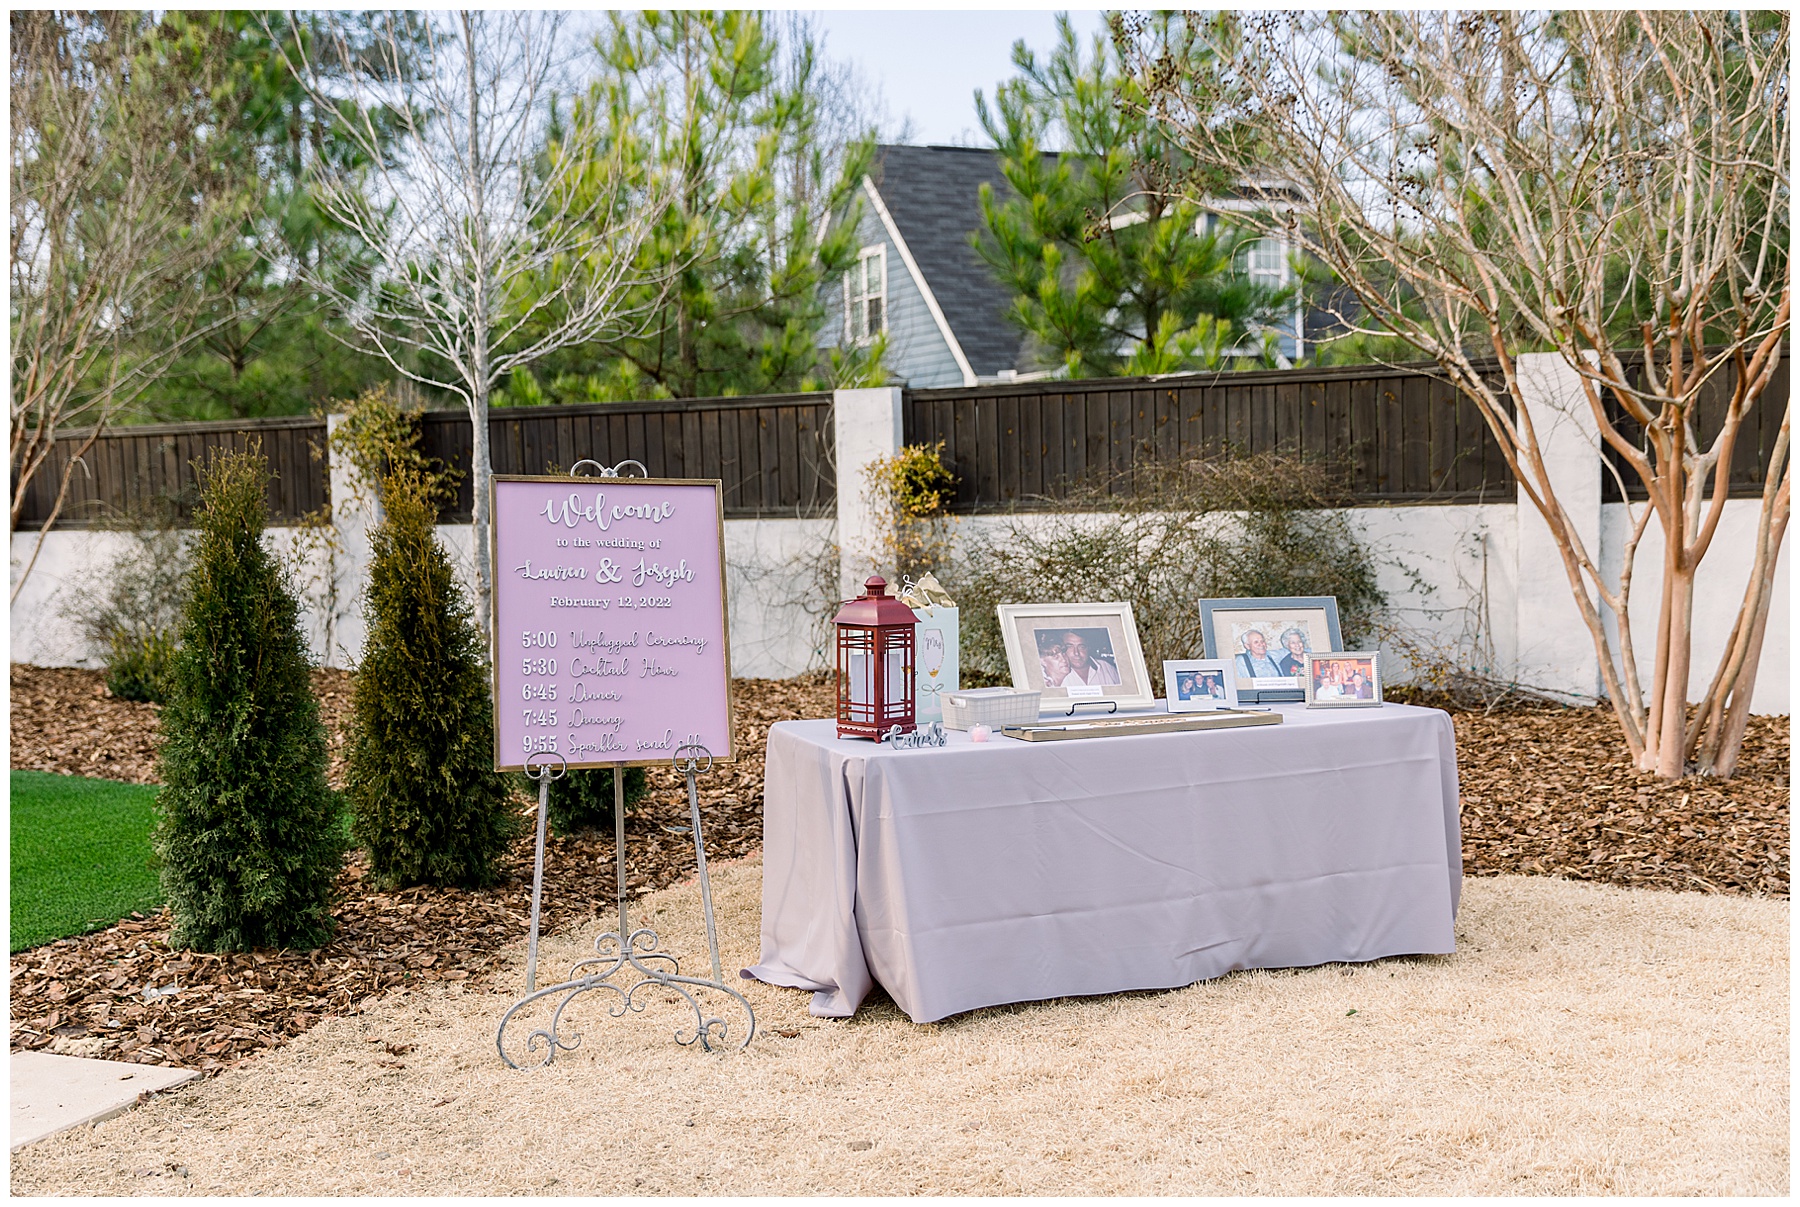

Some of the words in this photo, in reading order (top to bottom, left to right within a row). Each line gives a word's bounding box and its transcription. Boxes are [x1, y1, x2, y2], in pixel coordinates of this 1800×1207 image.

[540, 492, 676, 531] Welcome
[556, 537, 569, 548] to
[572, 537, 592, 548] the
[595, 537, 645, 550] wedding
[649, 538, 663, 549] of
[514, 559, 588, 580] Lauren
[595, 556, 623, 584] &
[631, 556, 696, 588] Joseph
[550, 596, 611, 610] February
[521, 630, 558, 648] 5:00
[570, 629, 639, 654] Unplugged
[645, 630, 708, 654] Ceremony
[521, 657, 558, 675] 5:30
[570, 657, 629, 677] Cocktail
[640, 658, 679, 678] Hour
[521, 683, 558, 701] 6:45
[568, 681, 622, 703] Dinner
[522, 708, 558, 727] 7:45
[568, 707, 624, 731] Dancing
[522, 735, 558, 752] 9:55
[568, 732, 628, 760] Sparkler
[636, 728, 673, 751] send
[881, 720, 948, 750] Cards
